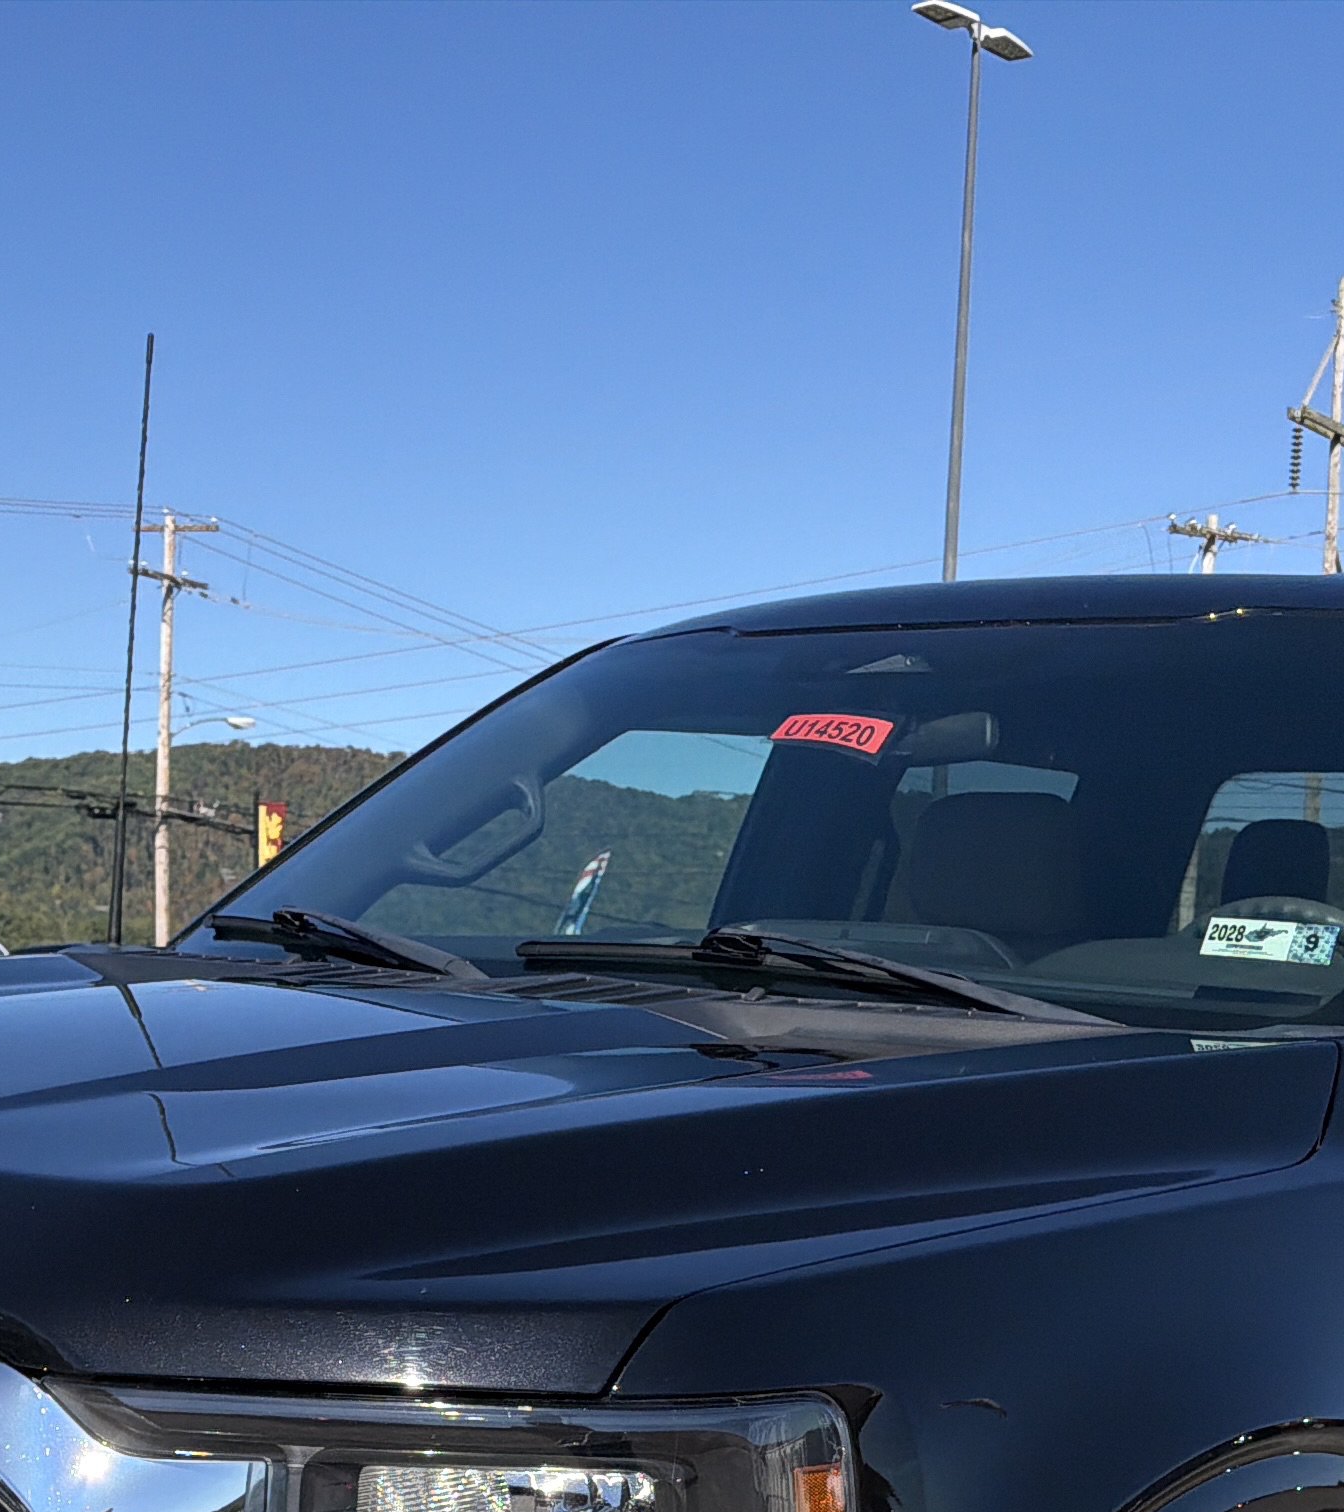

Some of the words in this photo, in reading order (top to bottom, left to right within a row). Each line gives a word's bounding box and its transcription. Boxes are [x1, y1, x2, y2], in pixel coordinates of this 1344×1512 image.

[784, 719, 876, 747] U14520
[1207, 923, 1246, 943] 2028
[1304, 933, 1320, 952] 9
